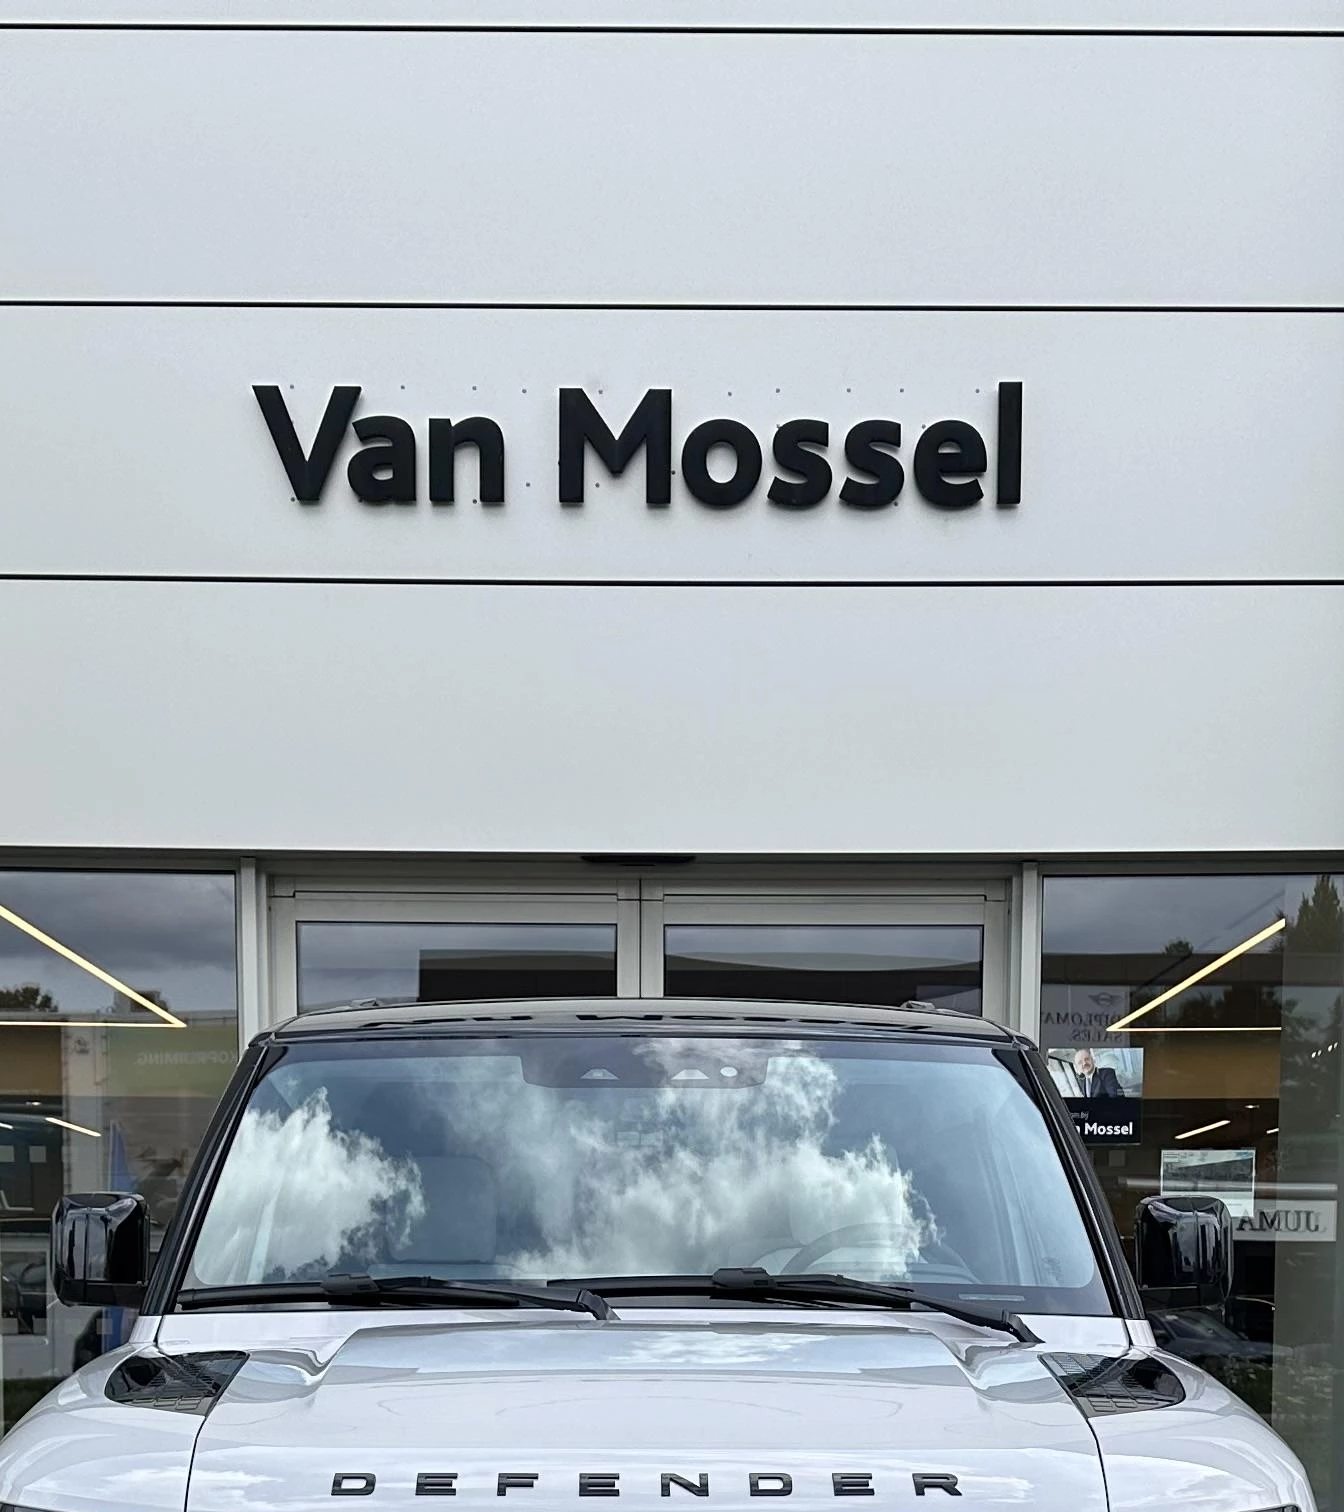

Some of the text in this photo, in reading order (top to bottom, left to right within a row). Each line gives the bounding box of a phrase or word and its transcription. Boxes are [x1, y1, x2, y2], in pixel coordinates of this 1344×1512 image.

[252, 382, 1022, 512] Van Mossel
[1084, 1122, 1133, 1136] Mossel
[331, 1472, 963, 1497] DEFENDER
